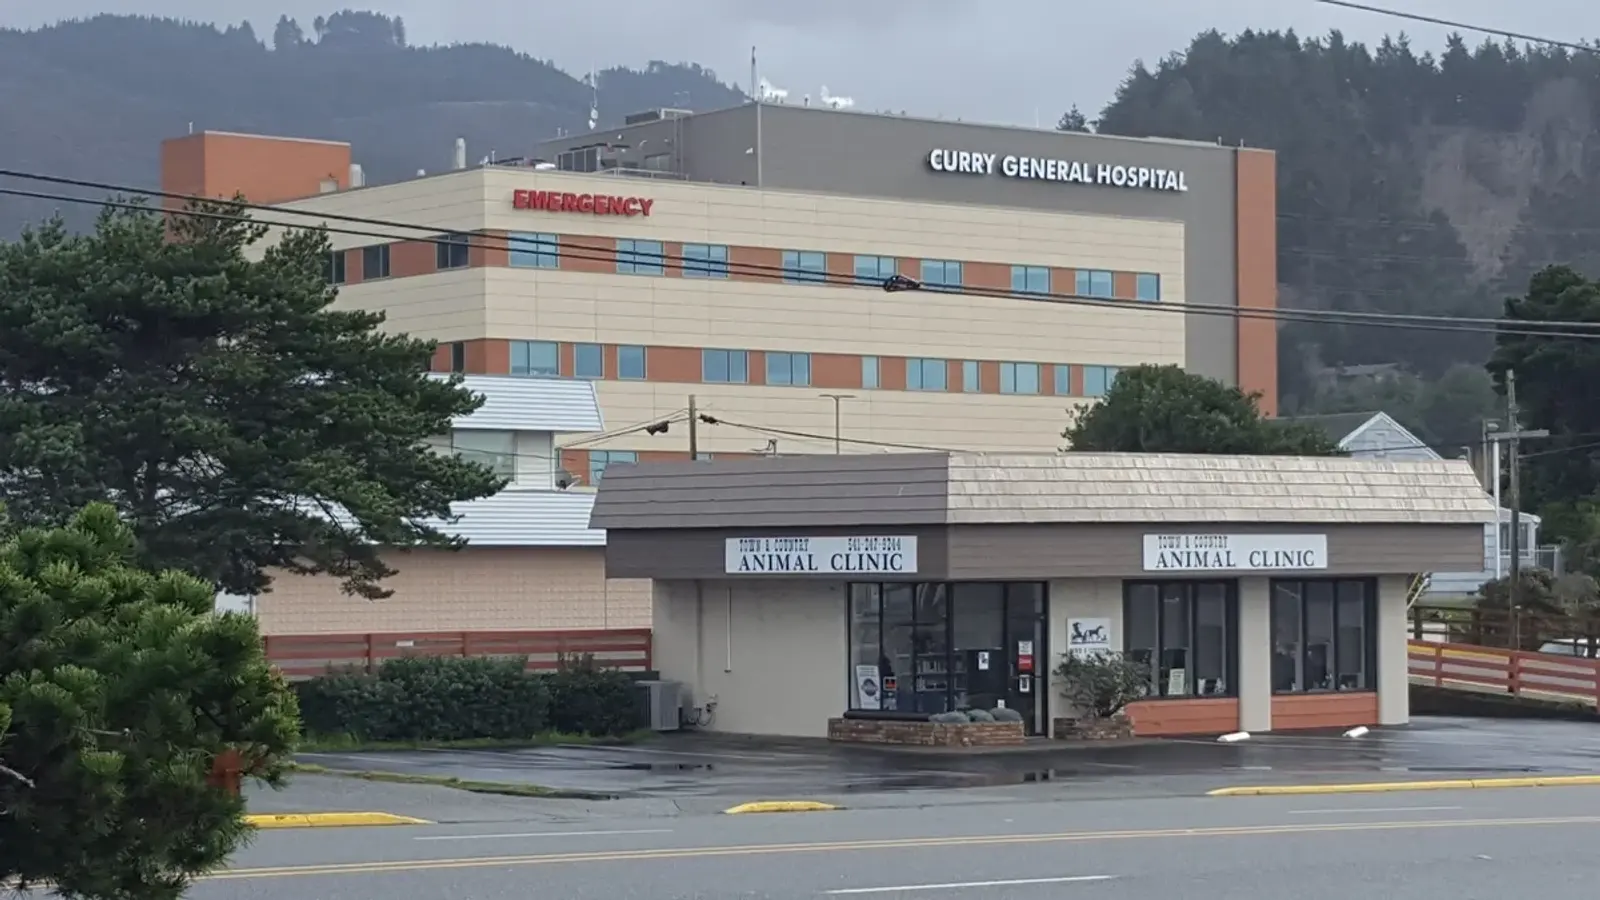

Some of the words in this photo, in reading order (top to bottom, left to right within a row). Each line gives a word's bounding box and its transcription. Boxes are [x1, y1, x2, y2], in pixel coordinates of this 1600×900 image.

[929, 148, 996, 174] CURRY
[1001, 155, 1093, 183] GENERAL
[1097, 164, 1189, 192] HOSPITAL
[513, 189, 653, 216] EMERGENCY
[739, 538, 761, 552] TOWN
[774, 538, 809, 552] COUNTRY
[1158, 535, 1180, 549] TOWN
[1194, 535, 1228, 549] COUNTRY
[739, 553, 818, 571] ANIMAL
[831, 552, 903, 570] CLINIC
[1156, 551, 1236, 568] ANIMAL
[1249, 550, 1315, 567] CLINIC
